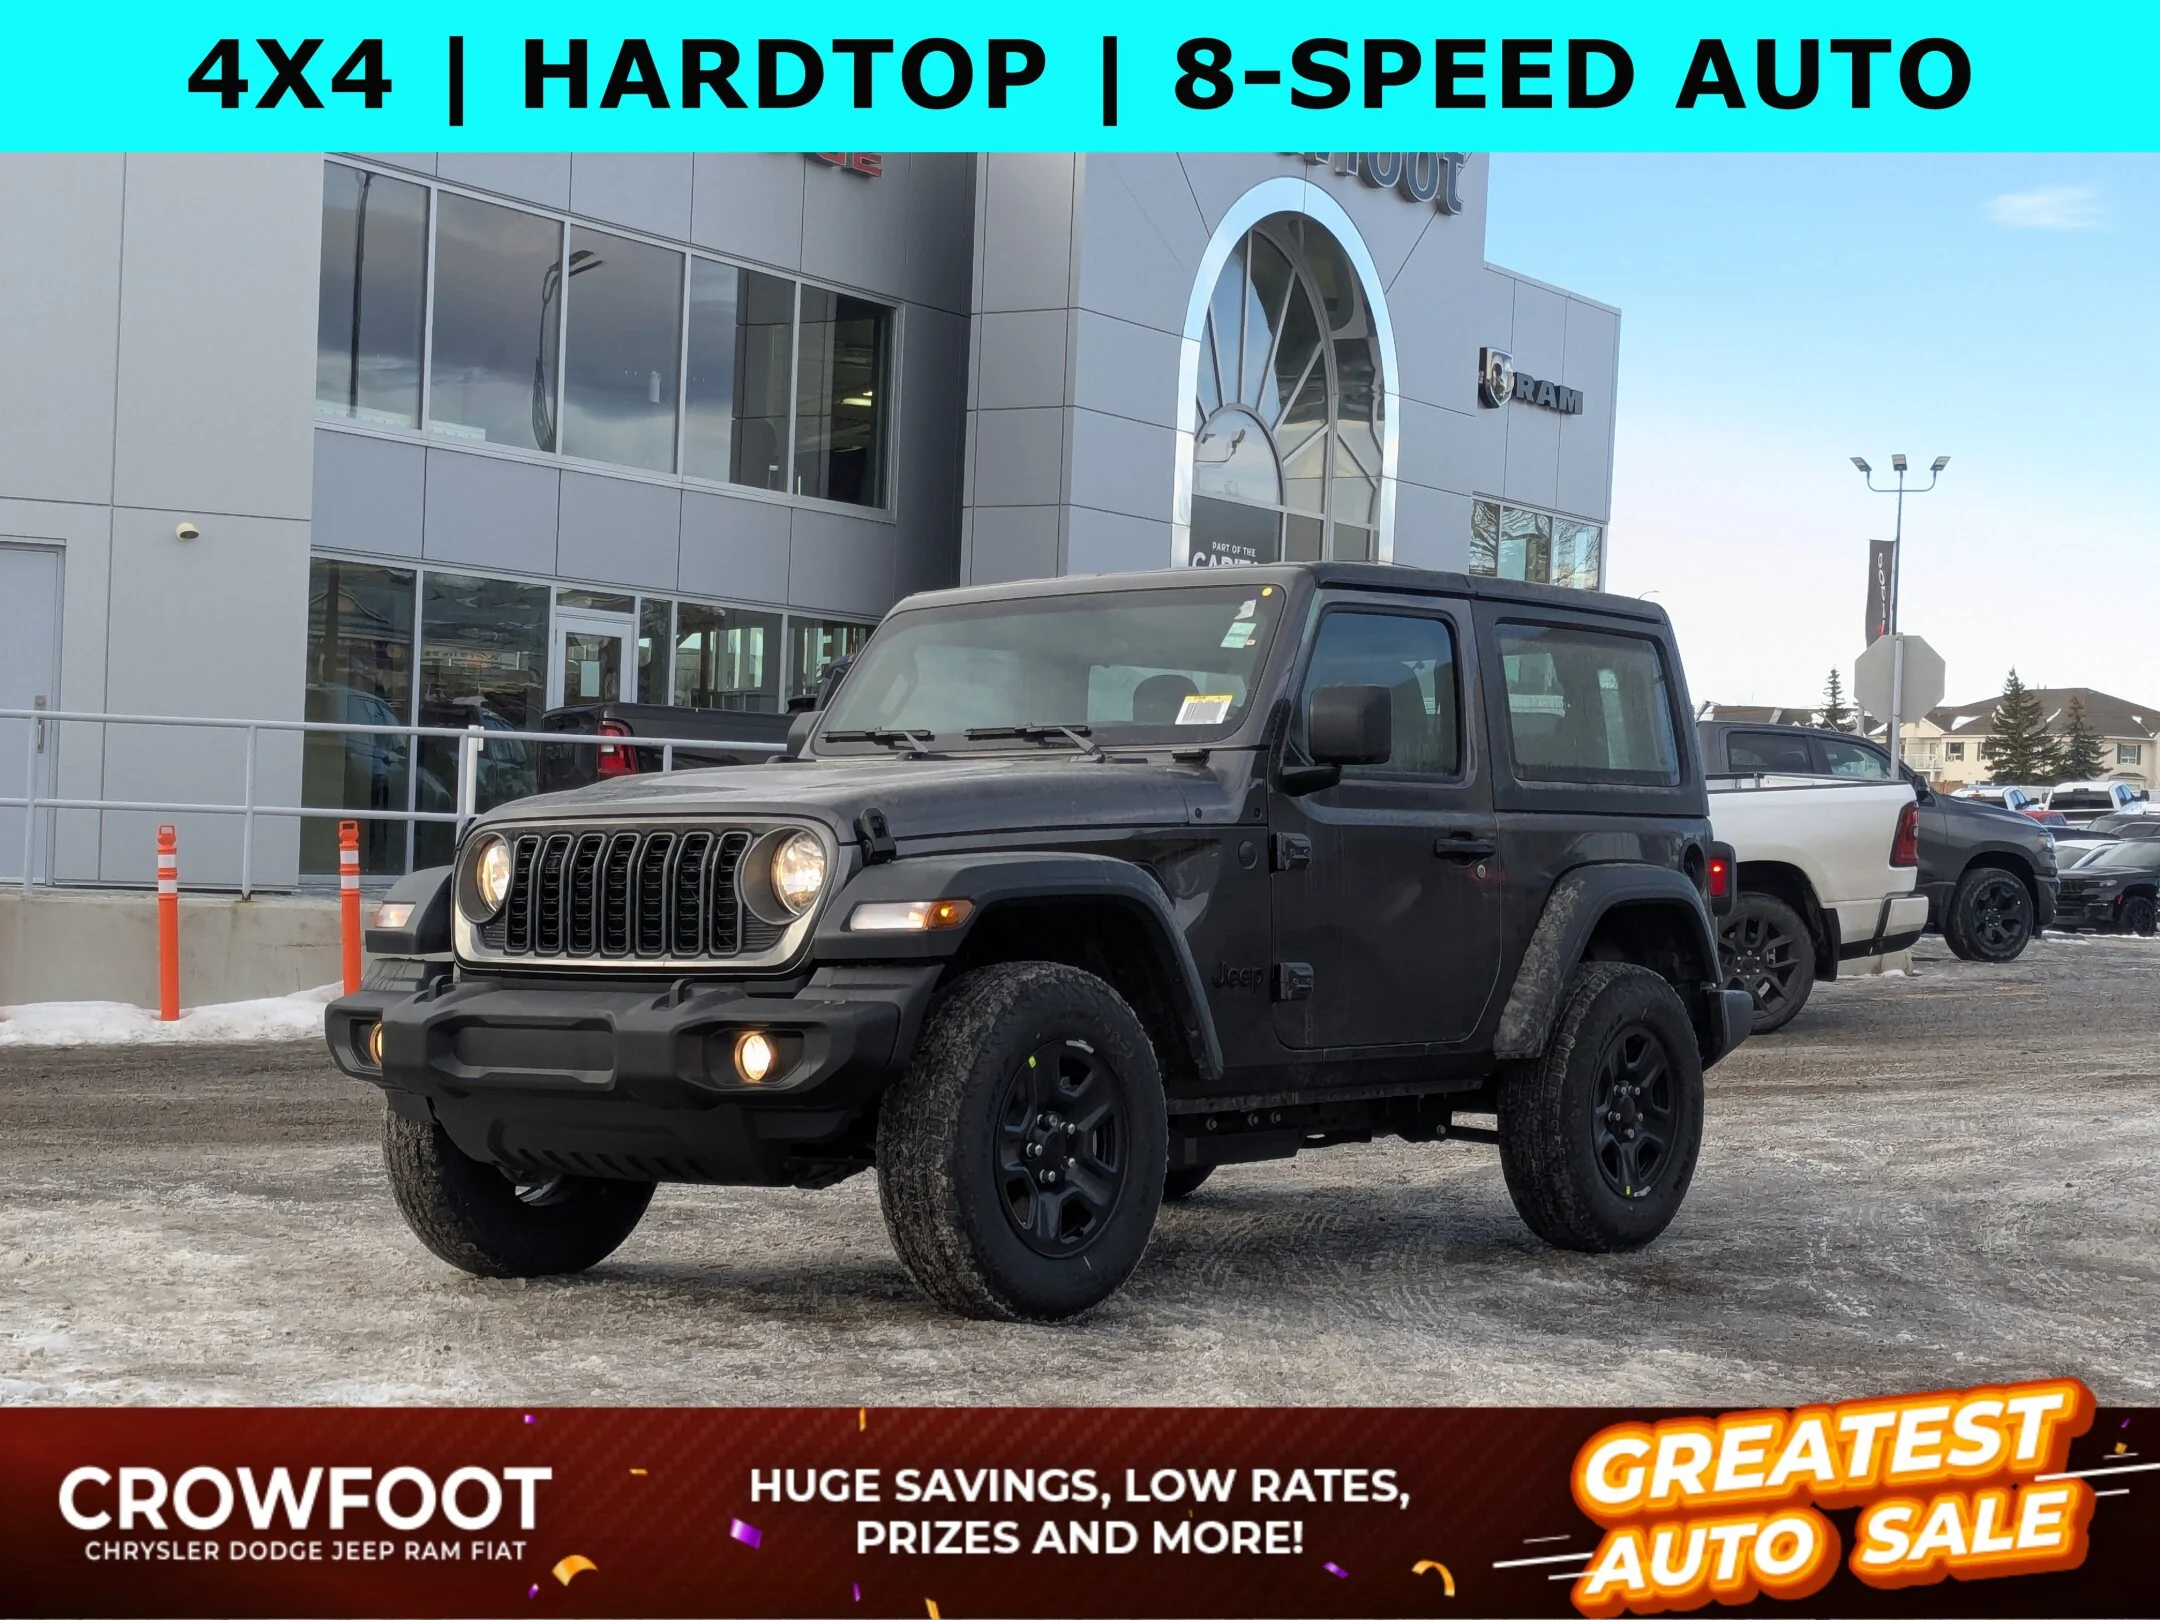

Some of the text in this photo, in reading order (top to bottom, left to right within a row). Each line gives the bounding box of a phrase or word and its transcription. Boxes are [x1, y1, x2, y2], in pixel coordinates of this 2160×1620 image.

[1513, 372, 1583, 415] RAM
[1212, 541, 1256, 558] PART OF THE
[1212, 960, 1264, 992] Jeep
